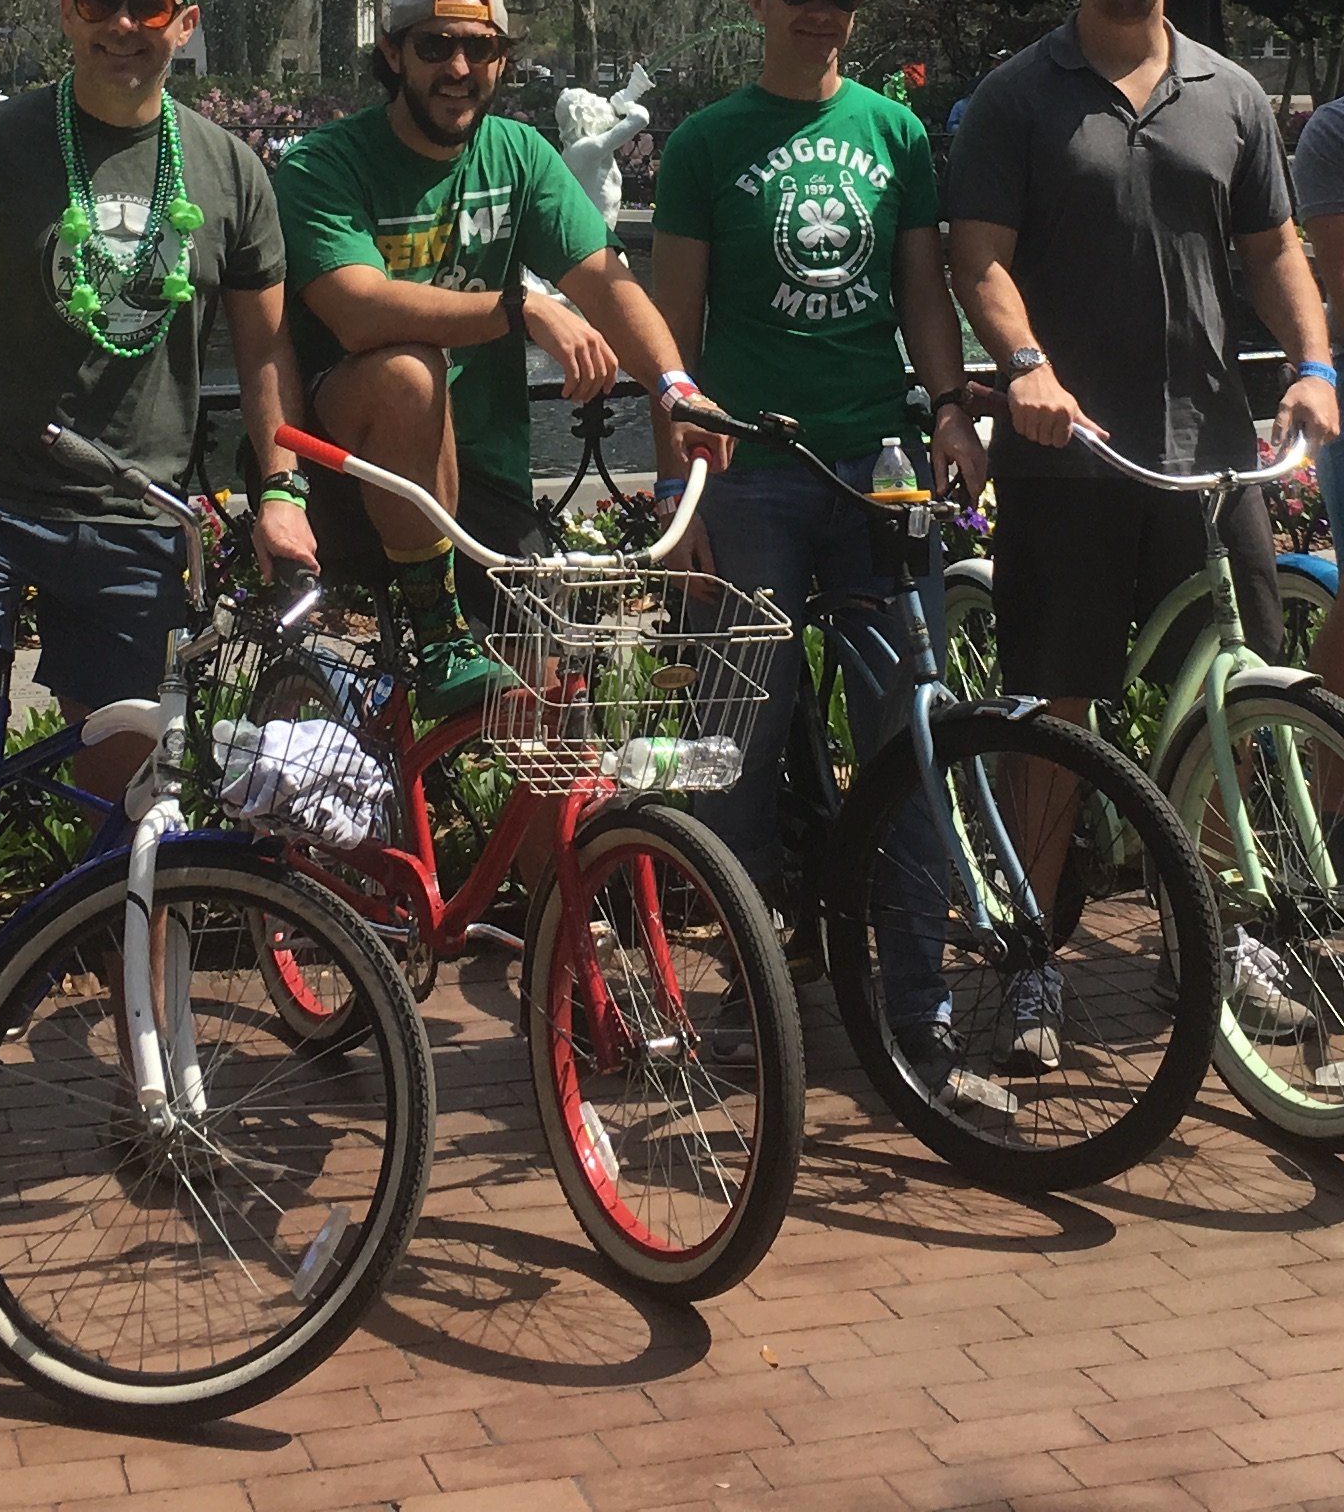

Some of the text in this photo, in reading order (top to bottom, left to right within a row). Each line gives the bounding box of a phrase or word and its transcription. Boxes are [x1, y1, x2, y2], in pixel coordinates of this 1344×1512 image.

[735, 137, 890, 196] FLOGGING
[97, 194, 113, 203] OF
[804, 184, 835, 195] 1997
[459, 202, 512, 247] ME
[771, 275, 879, 319] MOLLY
